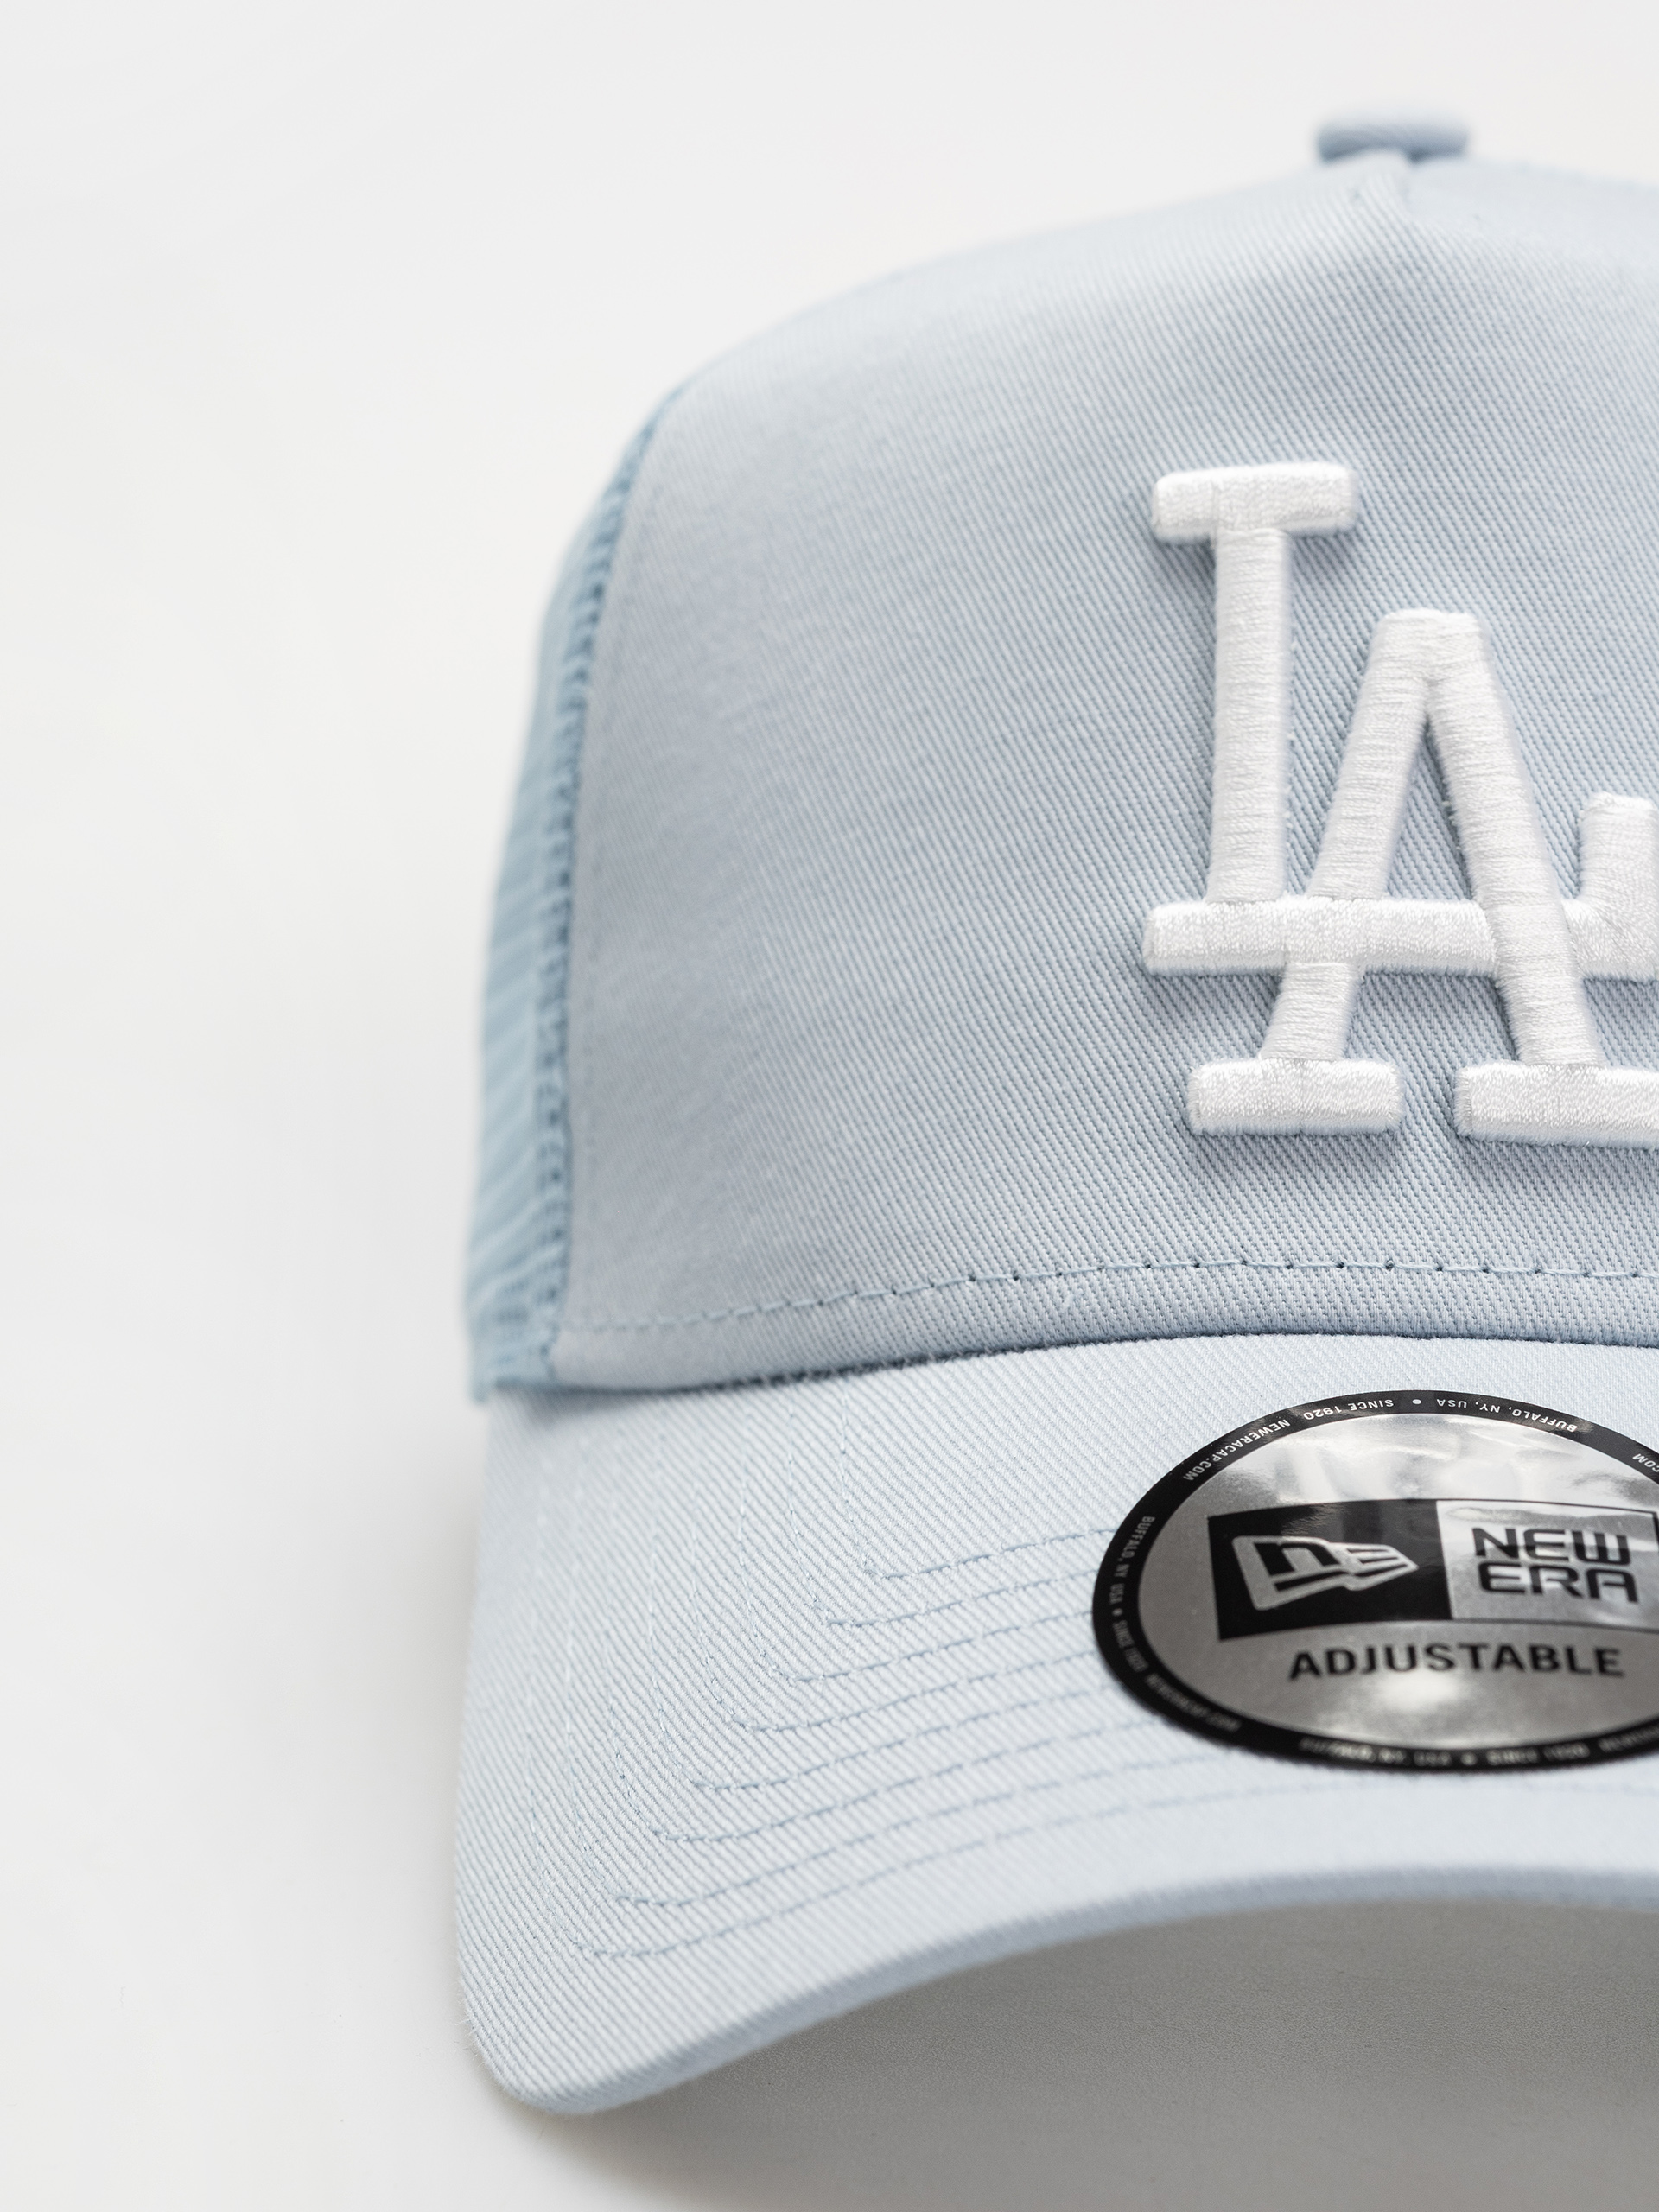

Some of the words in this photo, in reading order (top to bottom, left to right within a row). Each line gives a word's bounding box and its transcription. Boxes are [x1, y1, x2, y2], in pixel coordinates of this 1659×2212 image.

[1142, 461, 1659, 1149] LA
[1302, 1405, 1343, 1421] 1920
[1347, 1398, 1395, 1411] SINCE
[1436, 1398, 1468, 1408] USA
[1475, 1400, 1501, 1414] NY,
[1508, 1406, 1579, 1433] BUFFALO,
[1182, 1418, 1291, 1481] NEWERACAP.COM
[1471, 1527, 1631, 1566] NEW
[1478, 1561, 1639, 1603] ERA
[1288, 1643, 1626, 1681] ADJUSTABLE
